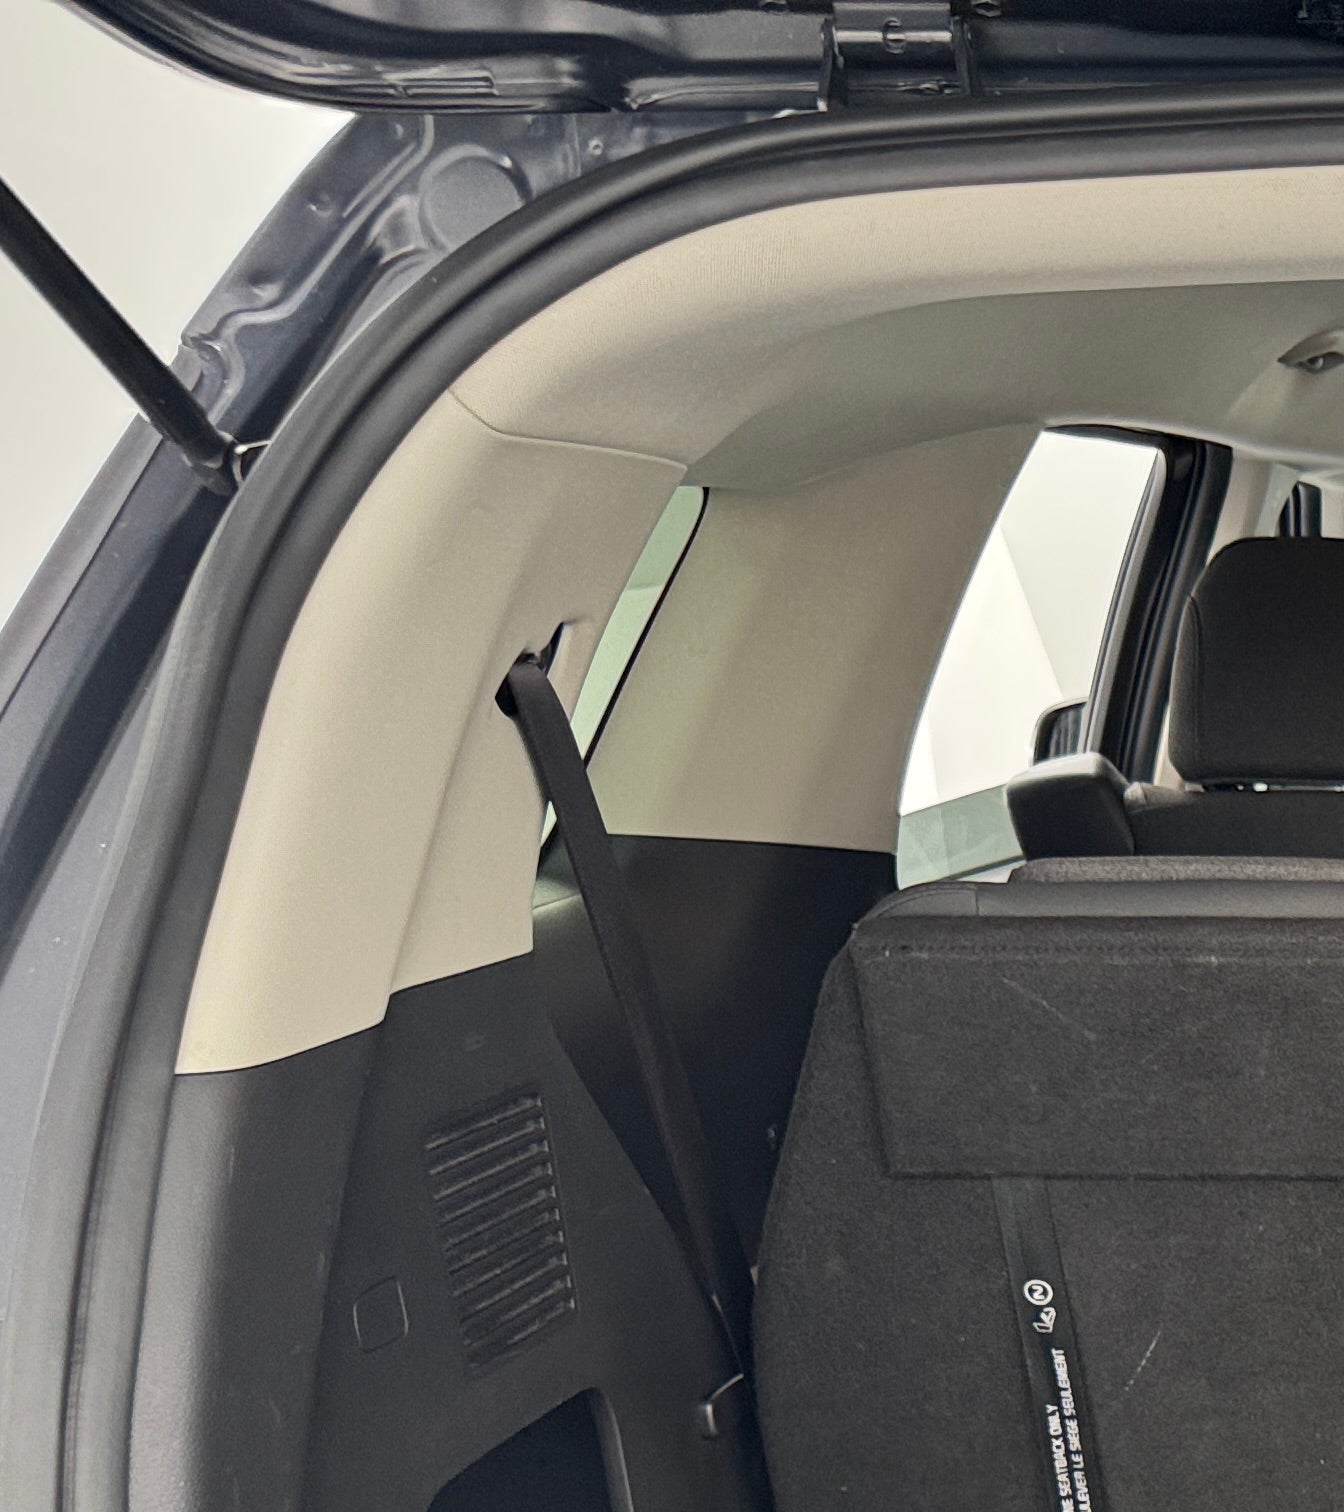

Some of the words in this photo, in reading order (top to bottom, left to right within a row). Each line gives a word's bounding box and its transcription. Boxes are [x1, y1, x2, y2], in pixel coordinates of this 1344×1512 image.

[1046, 1403, 1062, 1436] ONLY
[1051, 1438, 1073, 1497] SEATBACK
[1071, 1453, 1084, 1468] LE
